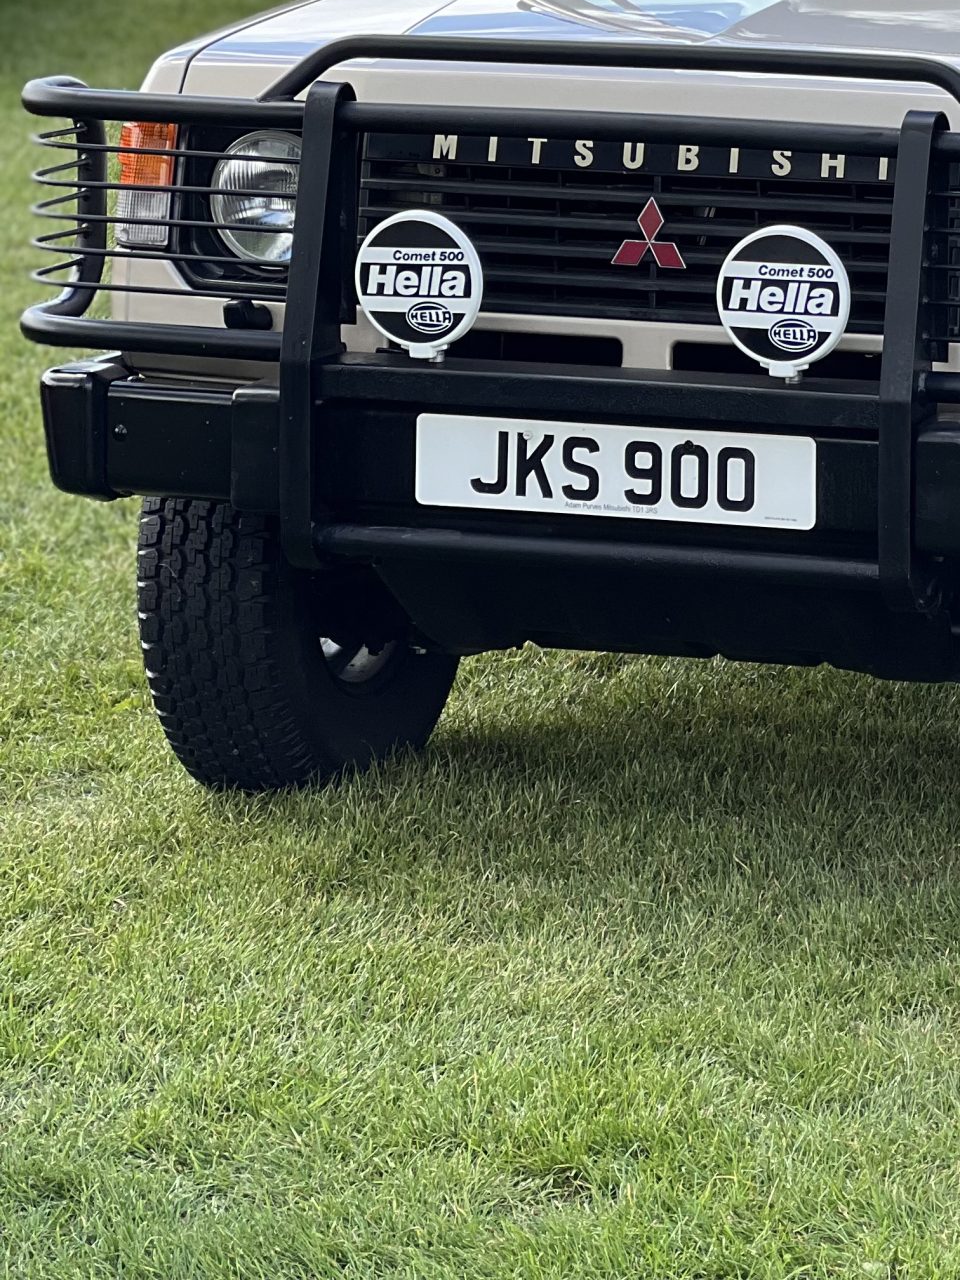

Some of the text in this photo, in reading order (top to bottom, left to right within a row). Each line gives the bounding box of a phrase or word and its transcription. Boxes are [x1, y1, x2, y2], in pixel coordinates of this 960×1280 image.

[432, 134, 888, 181] MITSUBISHI
[393, 250, 464, 262] Comet 500
[758, 265, 834, 278] Comet 500
[366, 264, 466, 297] Hella
[728, 279, 834, 315] Hella
[410, 311, 451, 324] HELLA
[773, 329, 816, 342] HELLA
[470, 431, 756, 513] JKS 900
[565, 501, 581, 509] Adam
[582, 502, 602, 510] Purves
